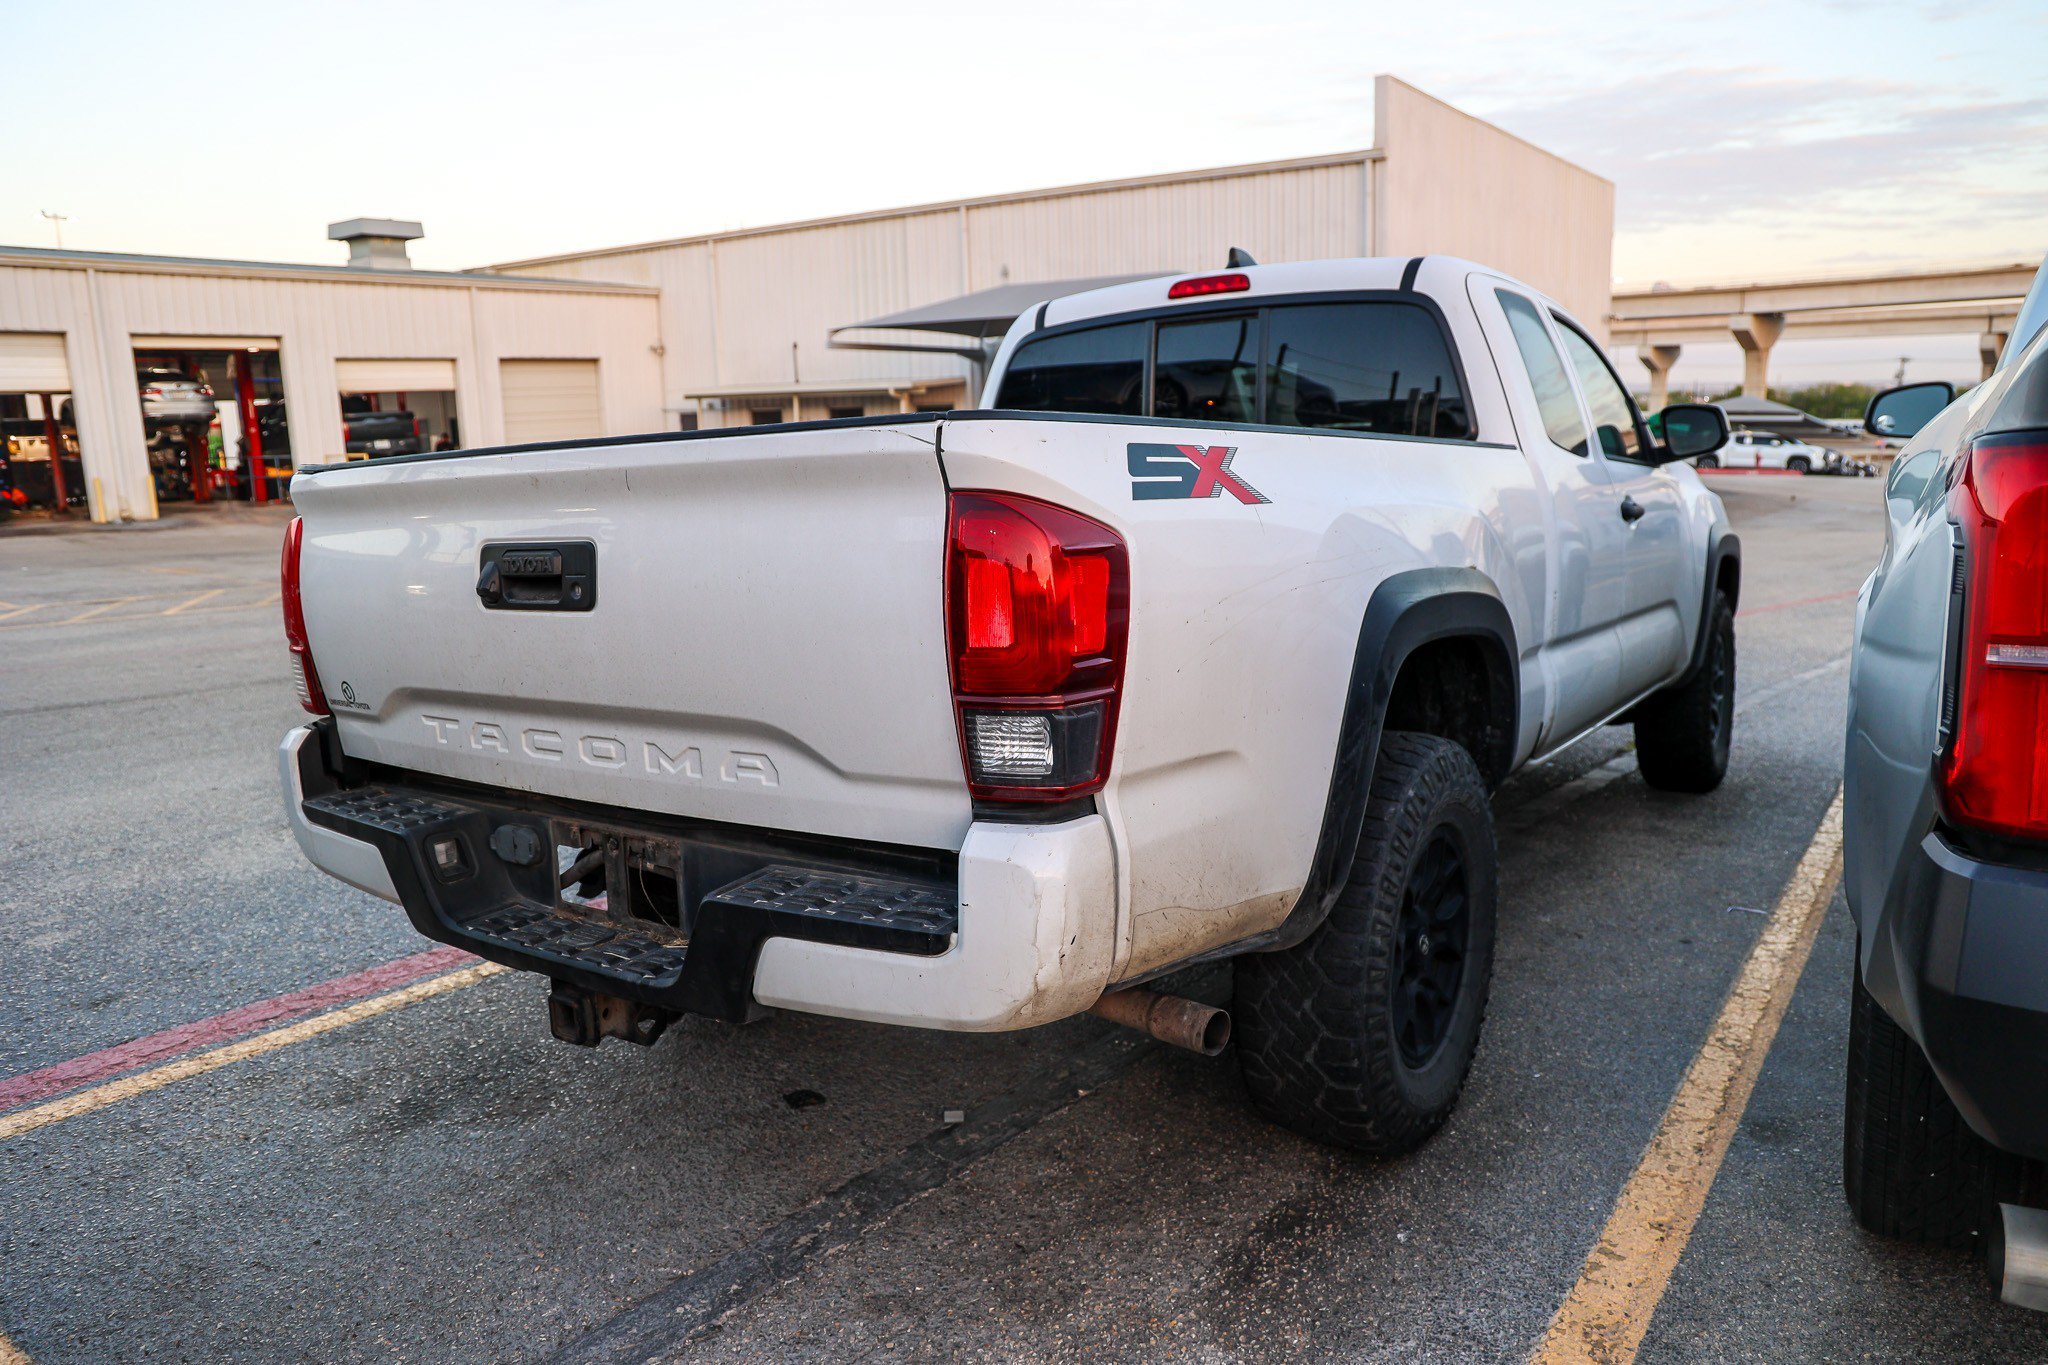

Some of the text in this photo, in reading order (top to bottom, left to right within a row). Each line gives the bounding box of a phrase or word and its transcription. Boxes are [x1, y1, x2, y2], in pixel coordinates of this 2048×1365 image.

[1127, 443, 1273, 505] SX
[503, 557, 553, 573] TOYOTA
[421, 714, 780, 787] TACOMA
